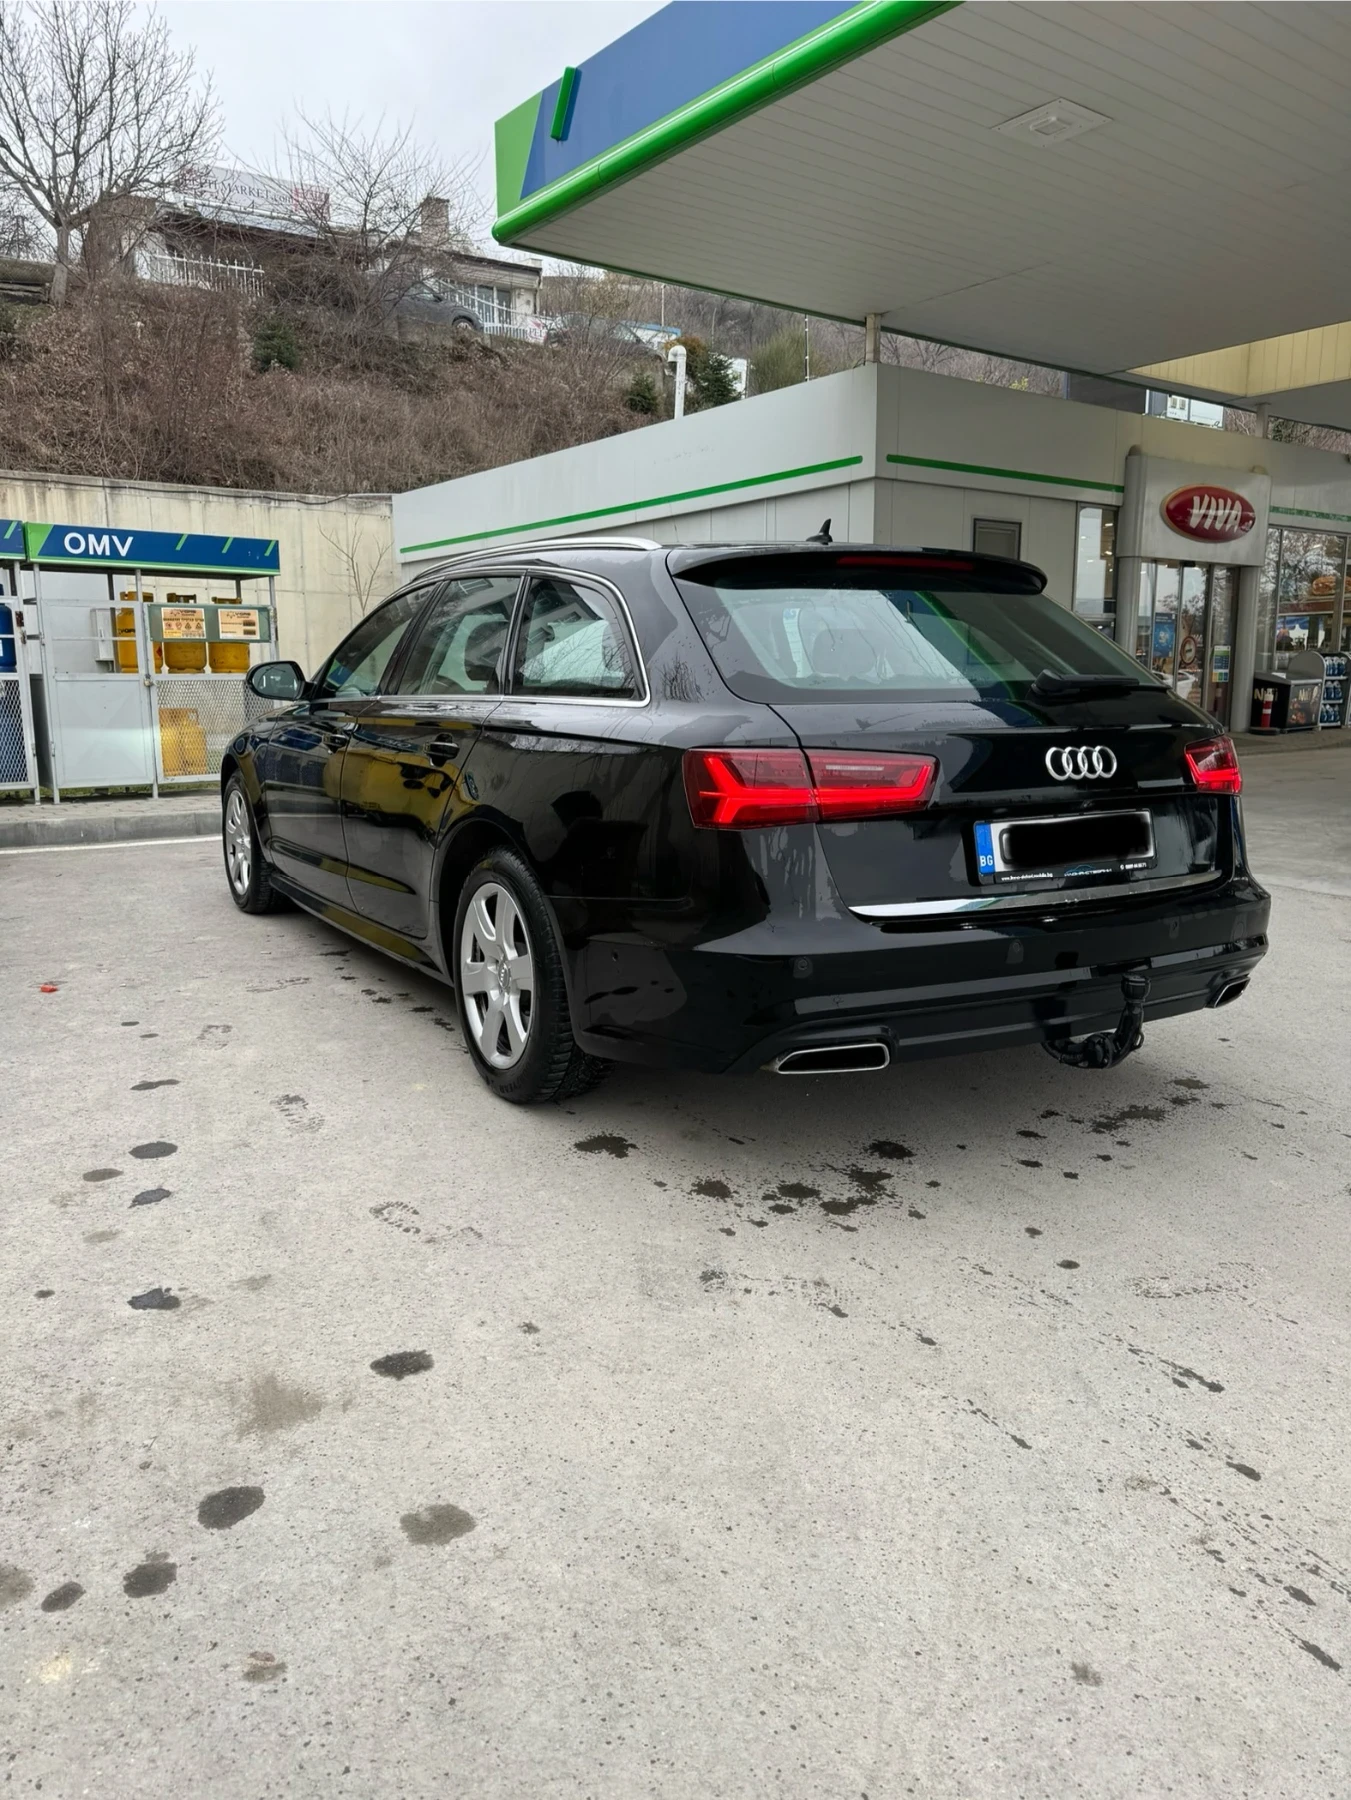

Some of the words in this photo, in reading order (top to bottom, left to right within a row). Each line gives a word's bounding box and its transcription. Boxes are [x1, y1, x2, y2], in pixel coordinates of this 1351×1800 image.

[1189, 494, 1242, 533] VIVA
[64, 532, 134, 557] OMV
[979, 855, 994, 867] BG
